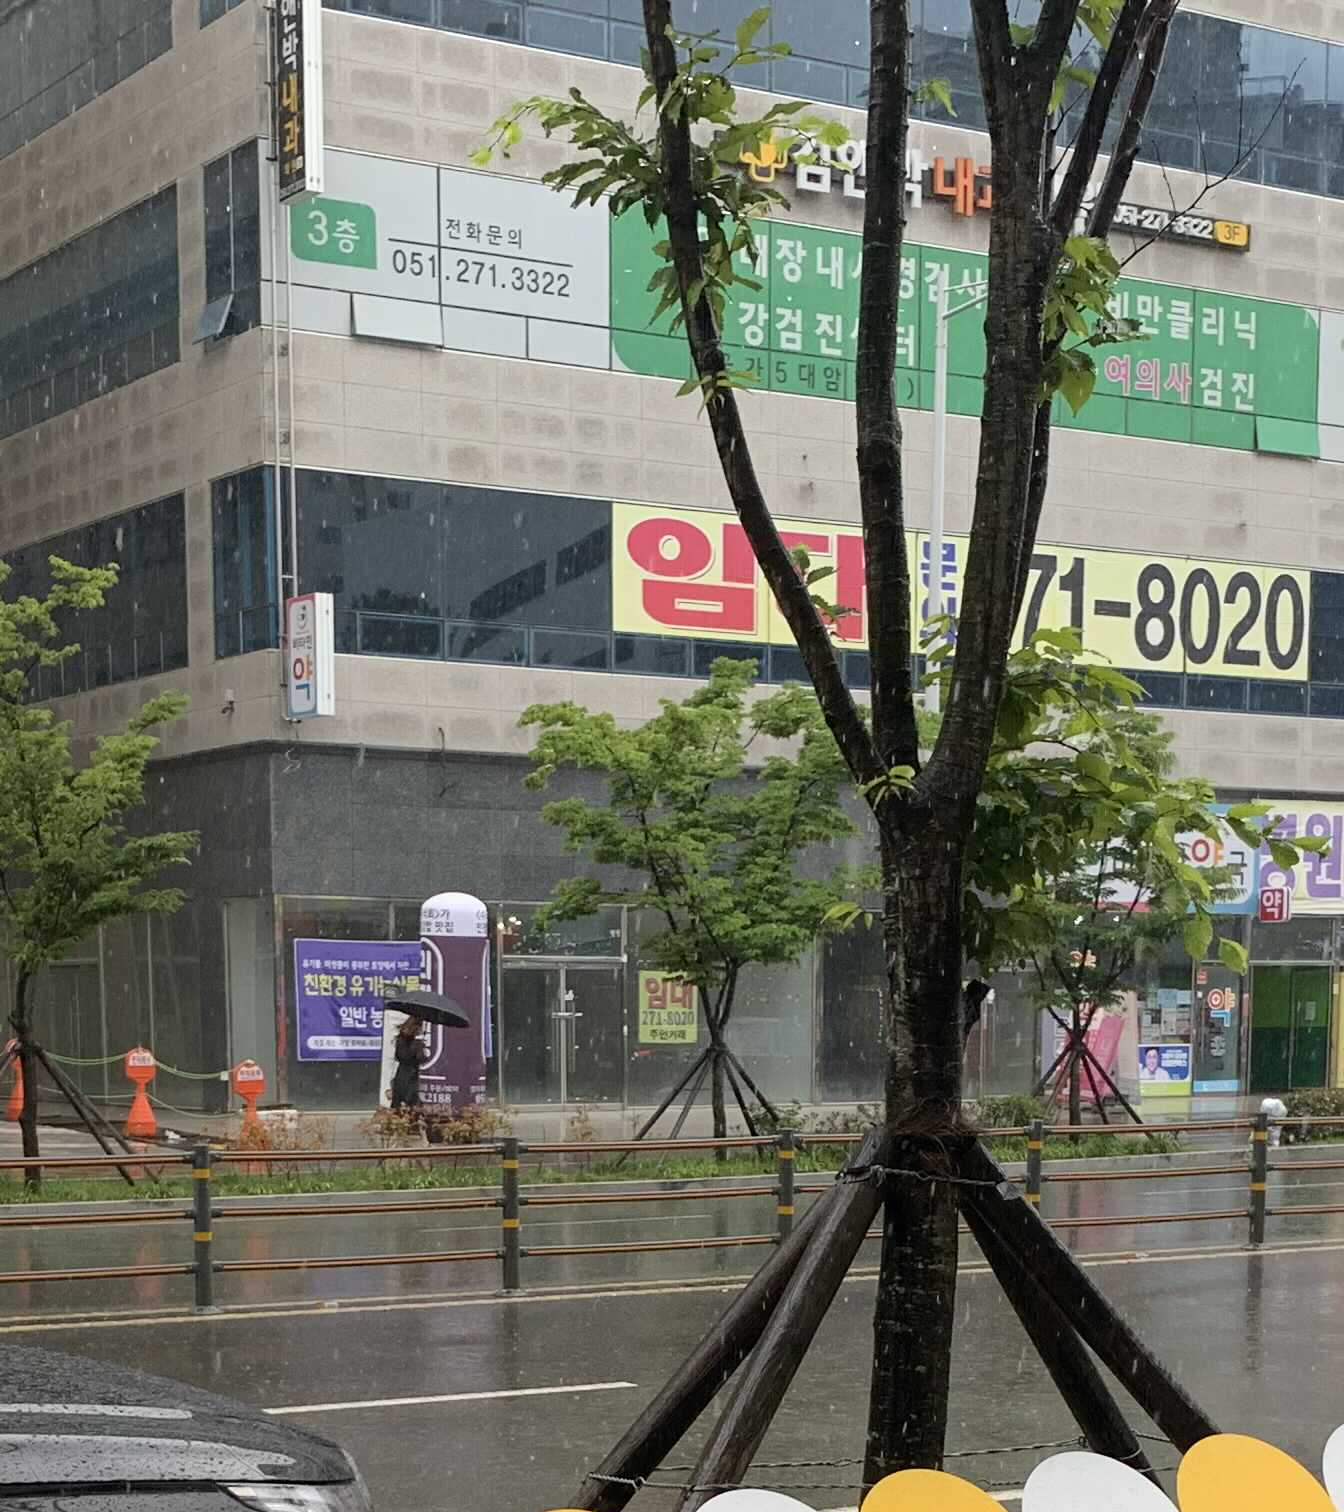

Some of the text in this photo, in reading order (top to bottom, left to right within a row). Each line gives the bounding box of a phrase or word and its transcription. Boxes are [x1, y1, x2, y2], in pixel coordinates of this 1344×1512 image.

[307, 208, 361, 255] 3층
[445, 217, 523, 250] 전화문의
[1223, 224, 1242, 242] 3F
[392, 247, 571, 299] 051.271.3322
[1104, 352, 1255, 412] 여의사 검진
[1262, 889, 1283, 919] 약
[303, 972, 347, 997] 친환경
[645, 977, 693, 1010] 임대
[339, 1006, 369, 1029] 일반
